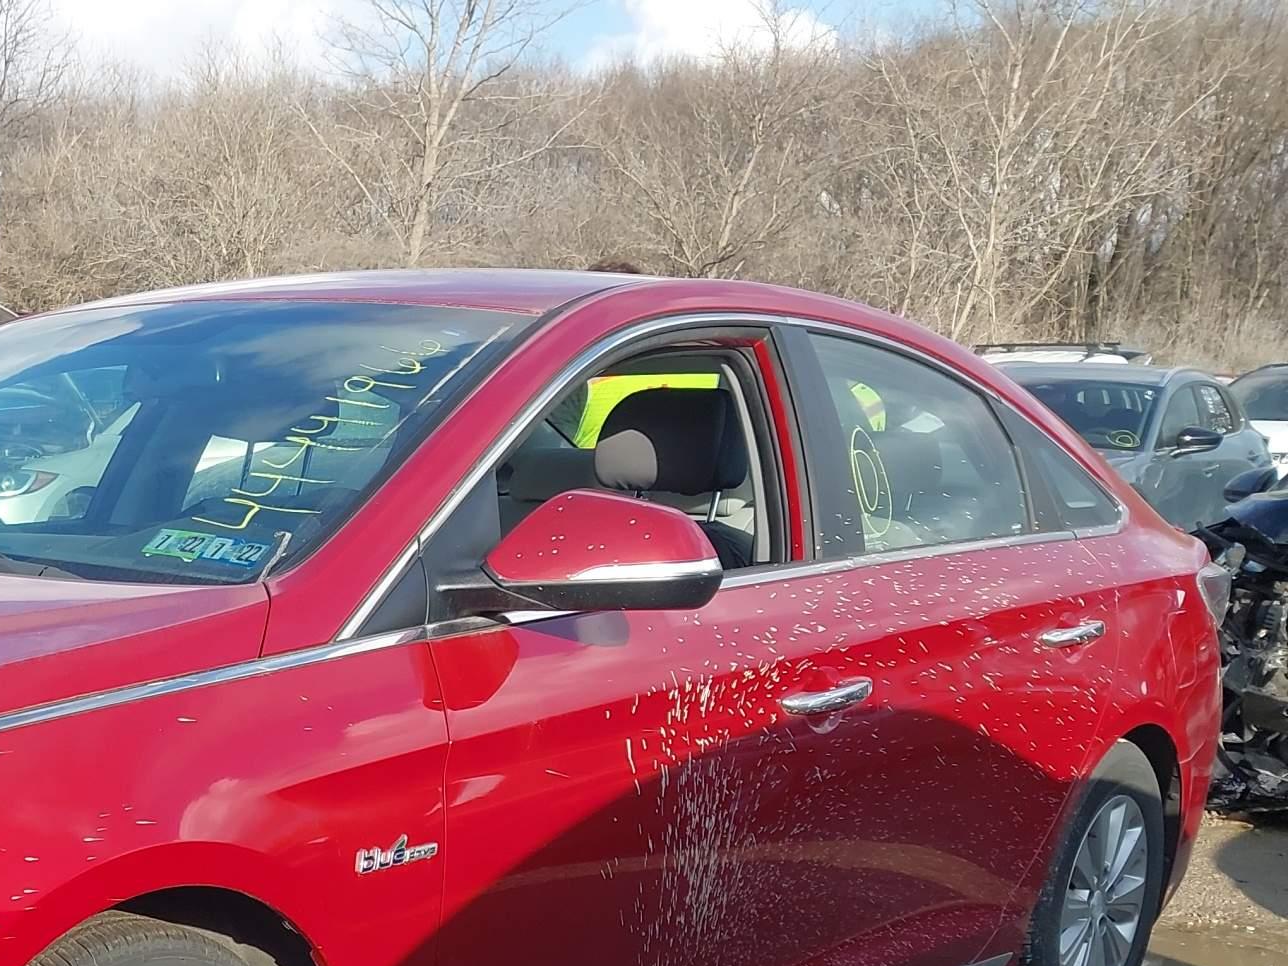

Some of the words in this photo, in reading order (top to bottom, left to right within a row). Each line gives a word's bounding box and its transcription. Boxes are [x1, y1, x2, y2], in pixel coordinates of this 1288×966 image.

[191, 338, 449, 530] 44441966
[156, 534, 172, 549] 7
[180, 536, 205, 553] 22
[211, 543, 225, 558] 7
